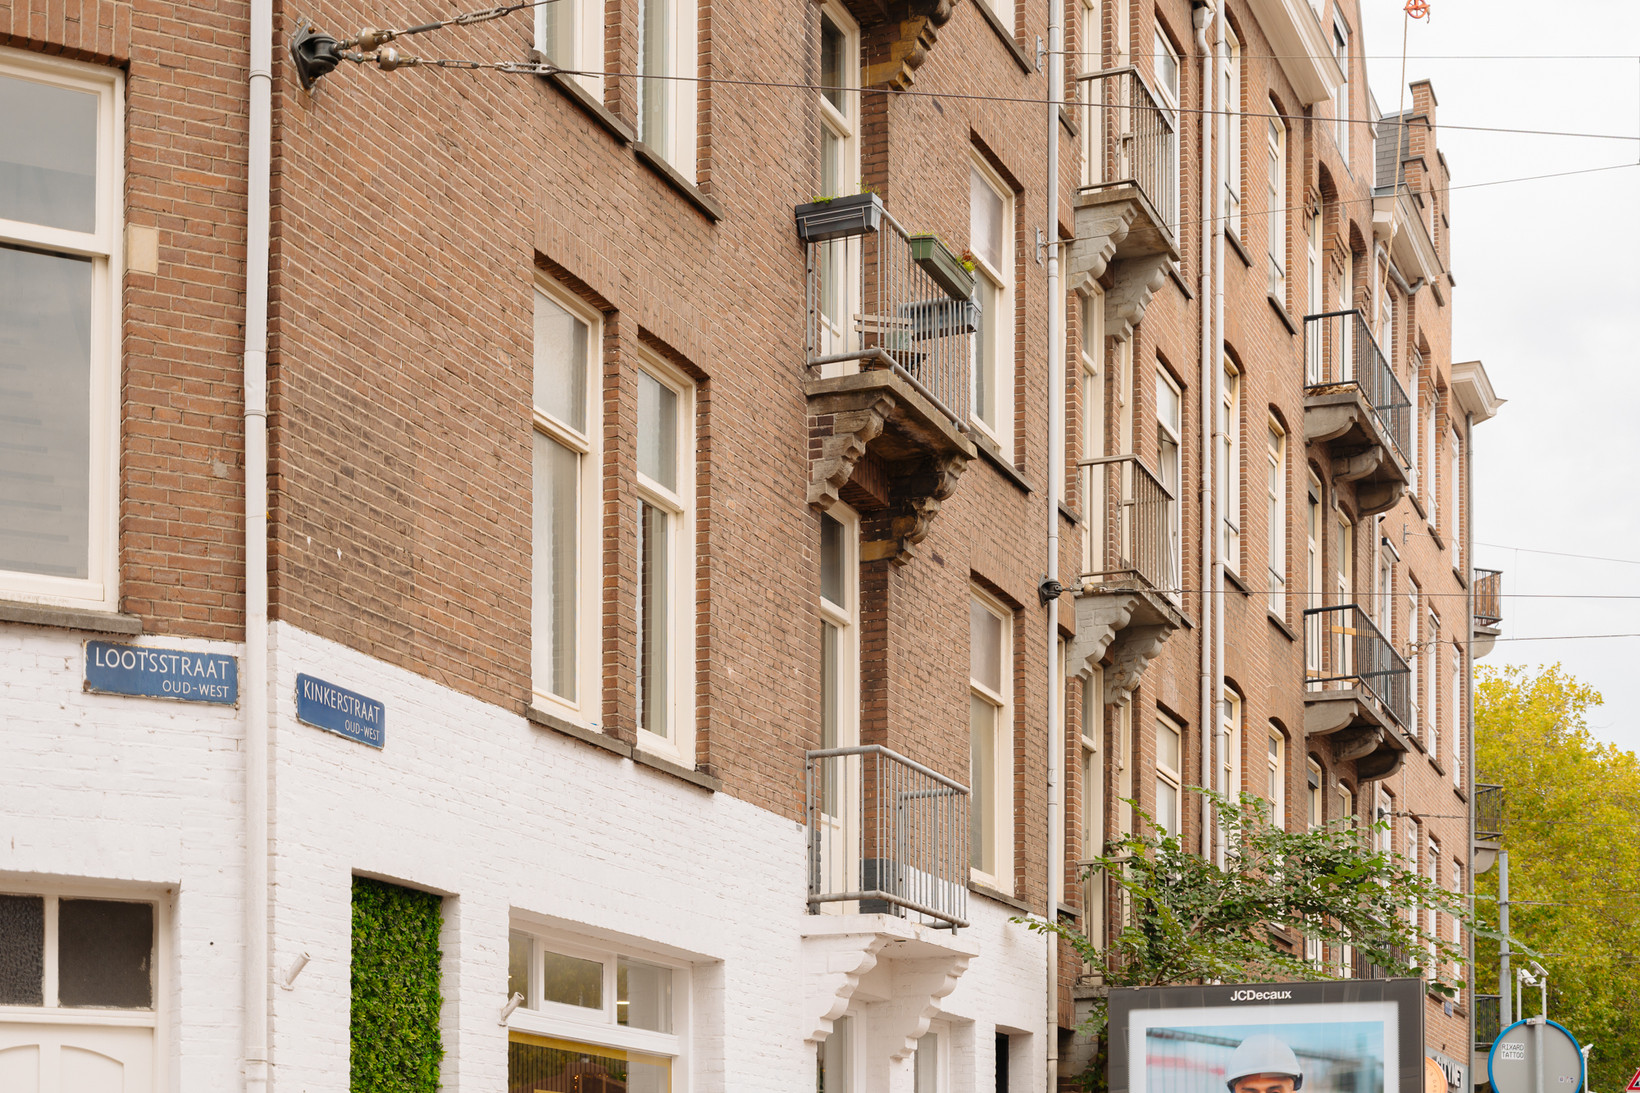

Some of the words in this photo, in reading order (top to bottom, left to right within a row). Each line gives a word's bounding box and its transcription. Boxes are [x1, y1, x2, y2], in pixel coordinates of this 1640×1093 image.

[162, 680, 229, 698] OUD-WEST
[304, 679, 380, 724] KINKERSTRAAT
[344, 719, 380, 741] OUD-WEST
[1230, 989, 1292, 1001] JCDecaux
